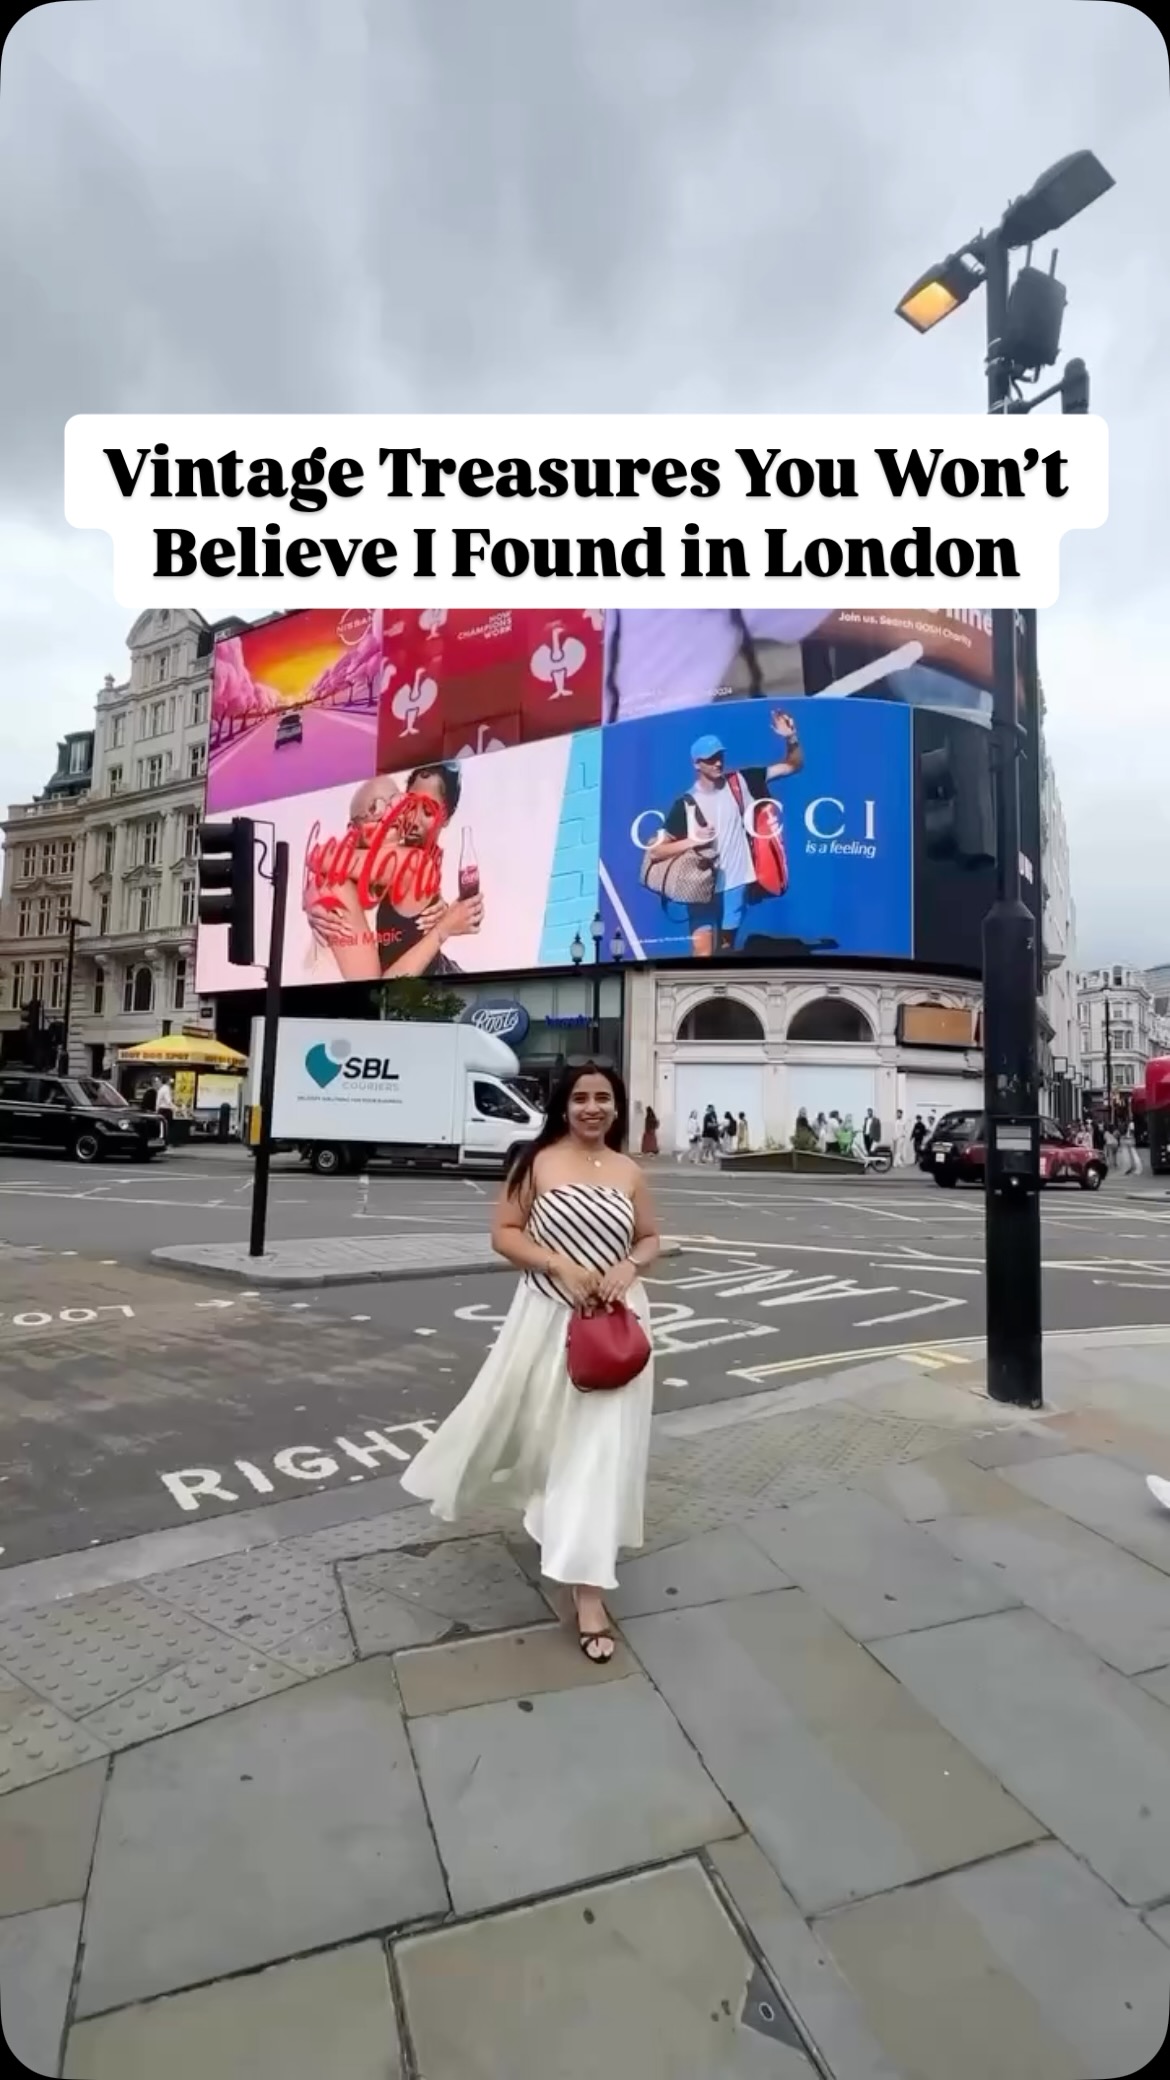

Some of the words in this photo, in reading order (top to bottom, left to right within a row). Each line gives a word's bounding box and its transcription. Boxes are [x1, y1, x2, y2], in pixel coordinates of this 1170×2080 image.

[457, 617, 512, 640] CHAMPIONS
[484, 626, 512, 639] WORK
[839, 611, 861, 623] Join
[863, 614, 878, 625] us.
[879, 615, 914, 630] Search
[942, 628, 972, 649] Charity
[630, 797, 876, 849] GUCCI
[805, 840, 817, 855] is
[818, 842, 828, 854] a
[829, 840, 877, 859] feeling
[327, 932, 358, 948] Real
[361, 927, 403, 947] Magic
[471, 1007, 521, 1037] Boots
[342, 1057, 400, 1080] SBL
[342, 1081, 400, 1091] COURIERS
[0, 1304, 135, 1326] LOO
[161, 1419, 437, 1511] RIGHT
